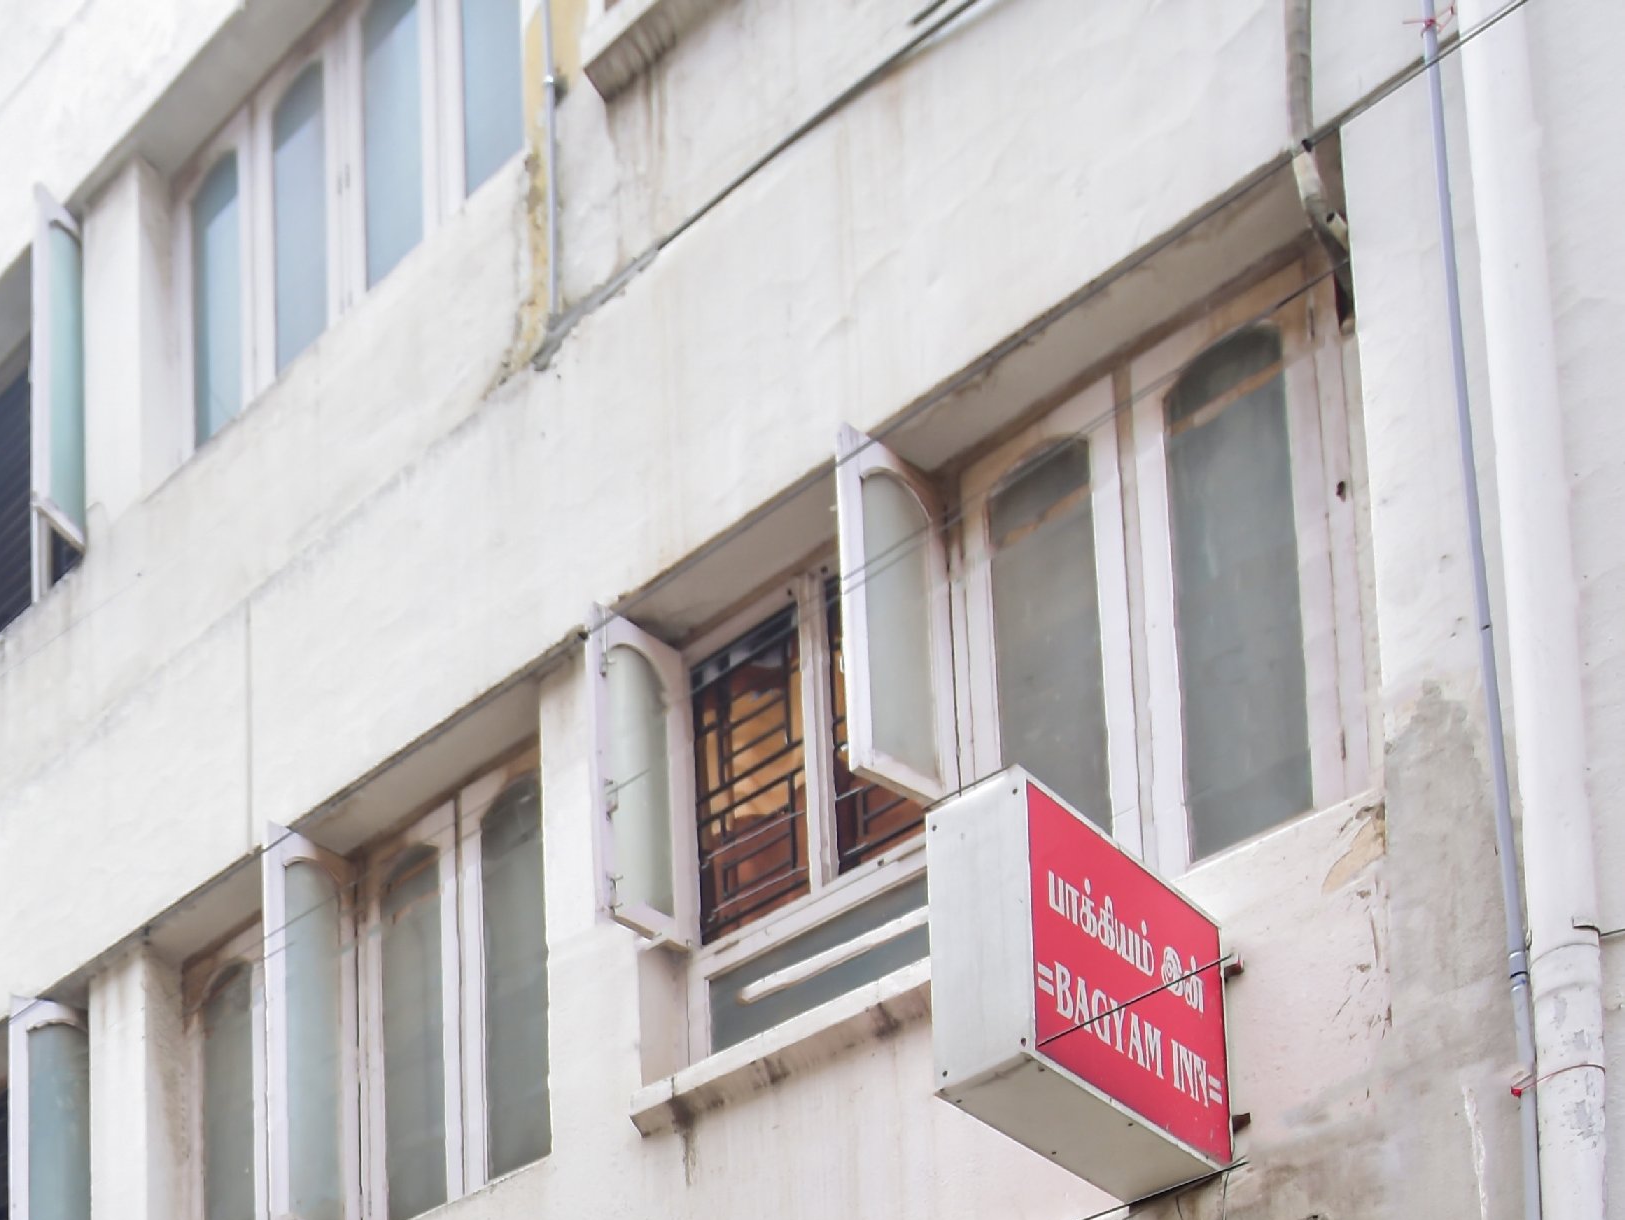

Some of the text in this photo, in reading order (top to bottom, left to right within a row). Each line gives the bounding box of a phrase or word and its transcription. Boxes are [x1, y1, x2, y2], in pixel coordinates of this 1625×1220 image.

[1047, 870, 1205, 1014] பாக்கியம் இன்
[1053, 961, 1211, 1107] BAGYAM INN
